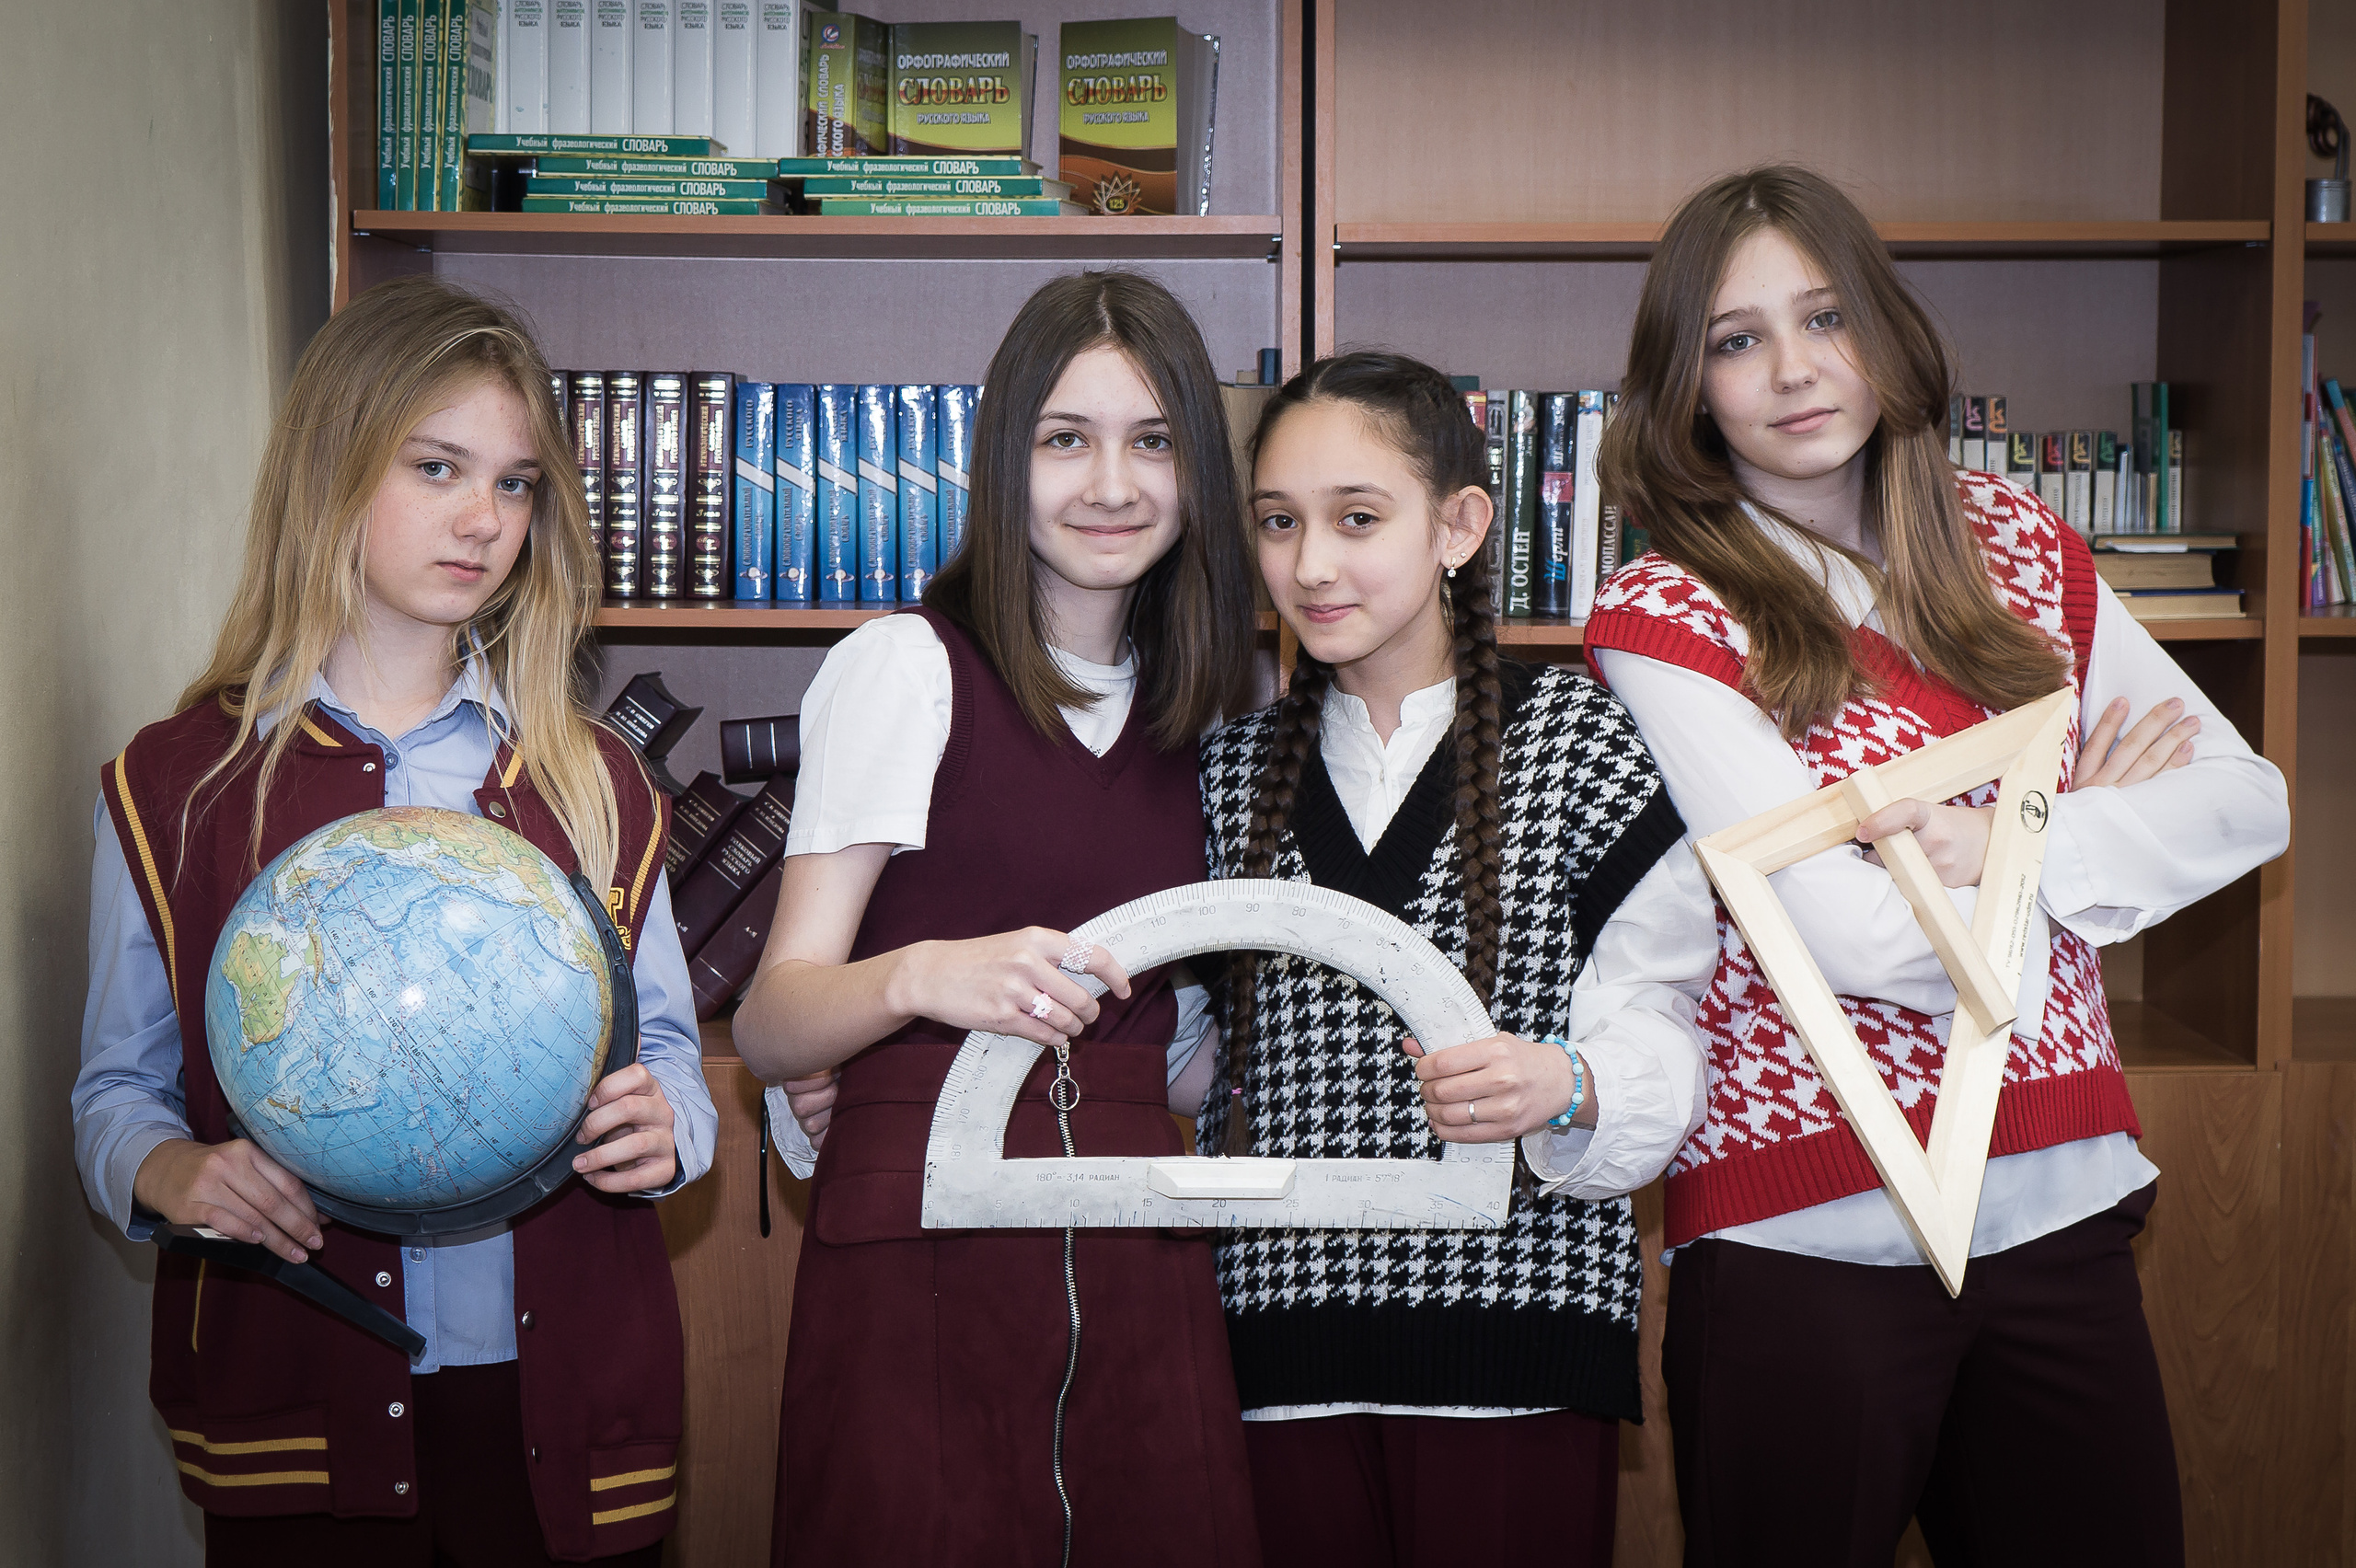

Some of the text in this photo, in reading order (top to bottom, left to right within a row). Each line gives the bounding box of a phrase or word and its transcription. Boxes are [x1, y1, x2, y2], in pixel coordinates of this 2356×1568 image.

[382, 16, 396, 62] СЛОВАРЬ
[401, 15, 414, 62] СЛОВАРЬ
[423, 15, 437, 62] СЛОВАРЬ
[448, 15, 463, 62] СЛОВАРЬ
[896, 51, 1010, 70] ОРФОГРАФИЧЕСКИЙ
[1066, 49, 1168, 70] ОРФОГРАФИЧЕСКИЙ
[898, 75, 1011, 106] СЛОВАРЬ
[1067, 75, 1167, 106] СЛОВАРЬ
[917, 111, 991, 125] РУССКОГО ЯЗЫКА
[1083, 110, 1149, 125] РУССКОГО ЯЗЫКА
[382, 137, 393, 168] Учебный
[400, 137, 410, 168] Учебный
[421, 137, 432, 168] Учебный
[445, 137, 456, 168] Учебный
[516, 137, 668, 153] Учебный фразеологический СЛОВАРЬ
[585, 160, 737, 177] Учебный фразеологический СЛОВАРЬ
[826, 161, 979, 175] Учебный фразеологический СЛОВАРЬ
[574, 181, 725, 196] Учебный фразеологический СЛОВАРЬ
[850, 180, 1001, 194] Учебный фразеологический СЛОВАРЬ
[569, 202, 719, 215] Учебный фразеологический СЛОВАРЬ
[871, 202, 1021, 216] Учебный фразеологический СЛОВАРЬ
[745, 398, 754, 448] РУССКОГО
[785, 399, 793, 449] РУССКОГО
[1510, 530, 1531, 611] Д. ОСТЕН
[727, 845, 752, 867] СЛОВАРЬ
[730, 836, 761, 865] ТОЛКОВЫЙ
[722, 847, 751, 874] РУССКОГО
[722, 858, 741, 876] ЯЗЫКА
[1197, 905, 1216, 917] 100
[1245, 903, 1260, 913] 90
[1291, 906, 1307, 917] 80
[1150, 916, 1167, 928] 110
[1338, 917, 1351, 929] 70
[1105, 933, 1124, 947] 120
[1375, 937, 1390, 950] 60
[1139, 945, 1149, 954] 2
[1410, 963, 1425, 975] 50
[1441, 997, 1454, 1009] 40
[974, 1065, 987, 1081] 160
[957, 1108, 971, 1124] 170
[951, 1144, 962, 1162] 180
[1067, 1173, 1084, 1183] 3,14
[995, 1200, 1002, 1208] 5
[1068, 1199, 1080, 1208] 10
[1142, 1198, 1153, 1207] 15
[1212, 1199, 1227, 1208] 20
[1285, 1199, 1299, 1208] 25
[1357, 1200, 1371, 1209] 30
[1429, 1201, 1443, 1210] 35
[1486, 1202, 1500, 1210] 40
